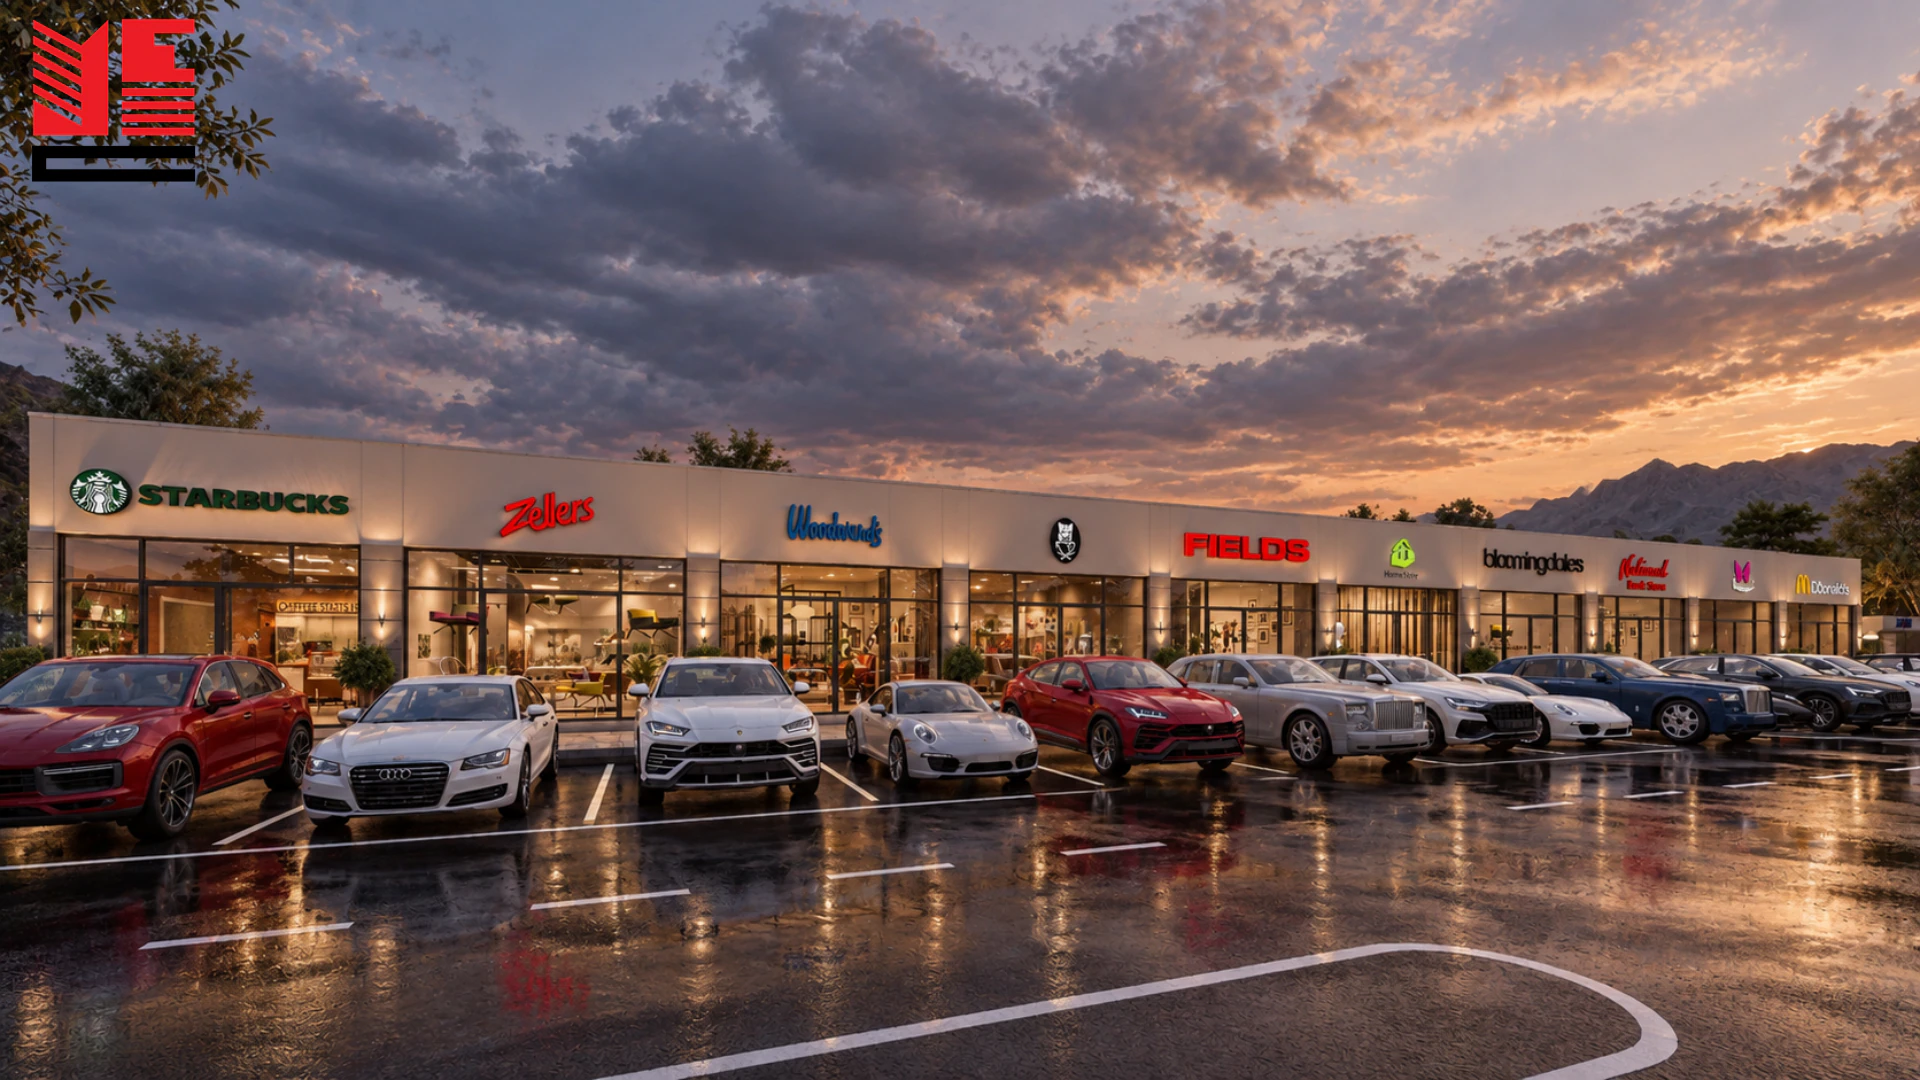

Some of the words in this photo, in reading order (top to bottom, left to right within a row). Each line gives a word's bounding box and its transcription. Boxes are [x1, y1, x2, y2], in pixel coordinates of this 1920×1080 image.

[138, 484, 349, 515] STARBUCKS
[500, 491, 595, 537] Zellers
[1183, 532, 1310, 563] FIELDS
